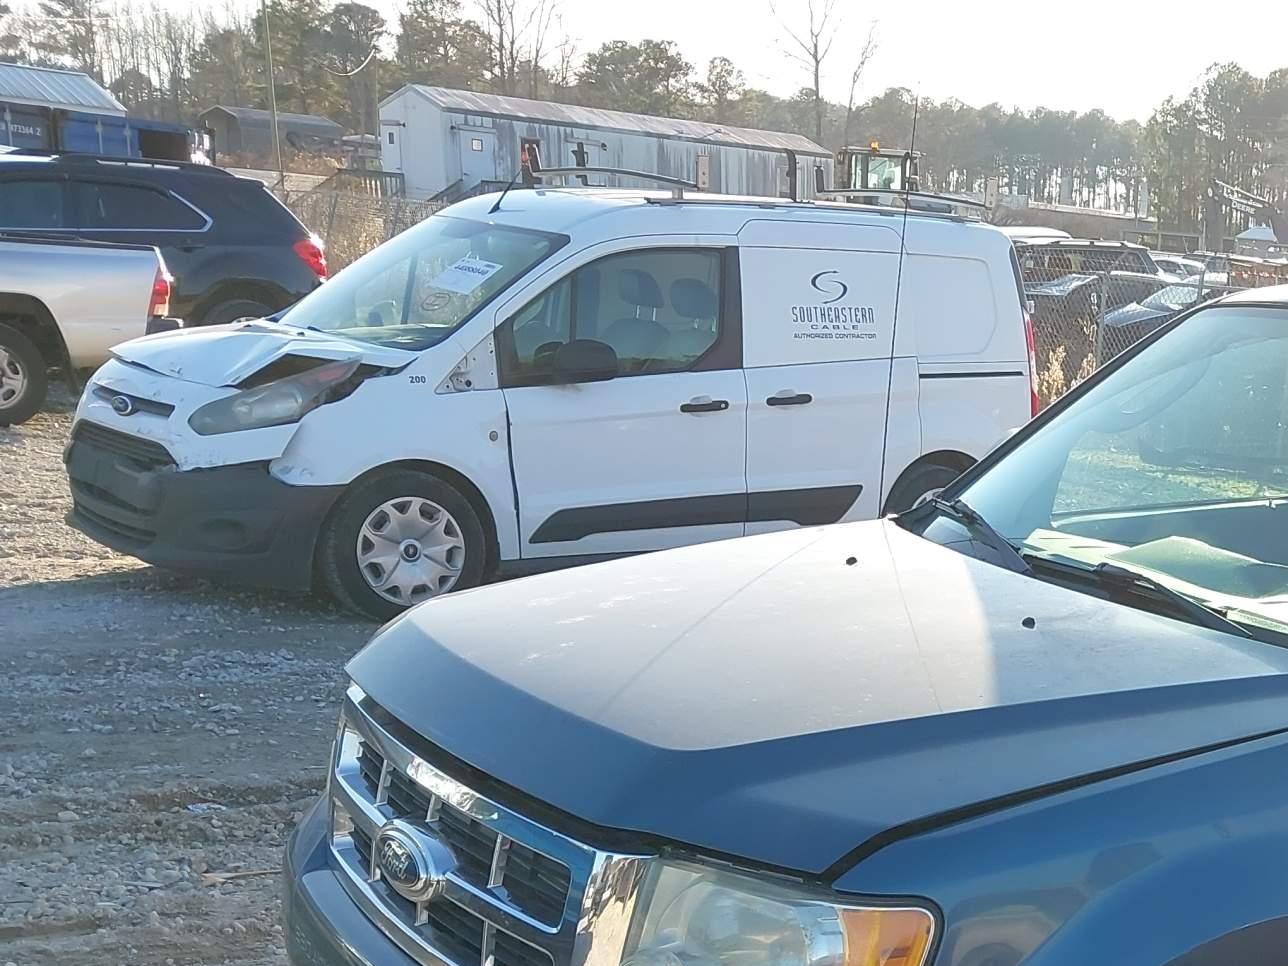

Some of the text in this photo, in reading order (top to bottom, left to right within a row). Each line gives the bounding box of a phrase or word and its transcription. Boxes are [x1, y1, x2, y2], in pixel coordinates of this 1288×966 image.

[791, 306, 875, 324] SOUTHEASTERN
[793, 332, 877, 340] AUTHORIZED CONTRACTOR
[408, 375, 427, 384] 200
